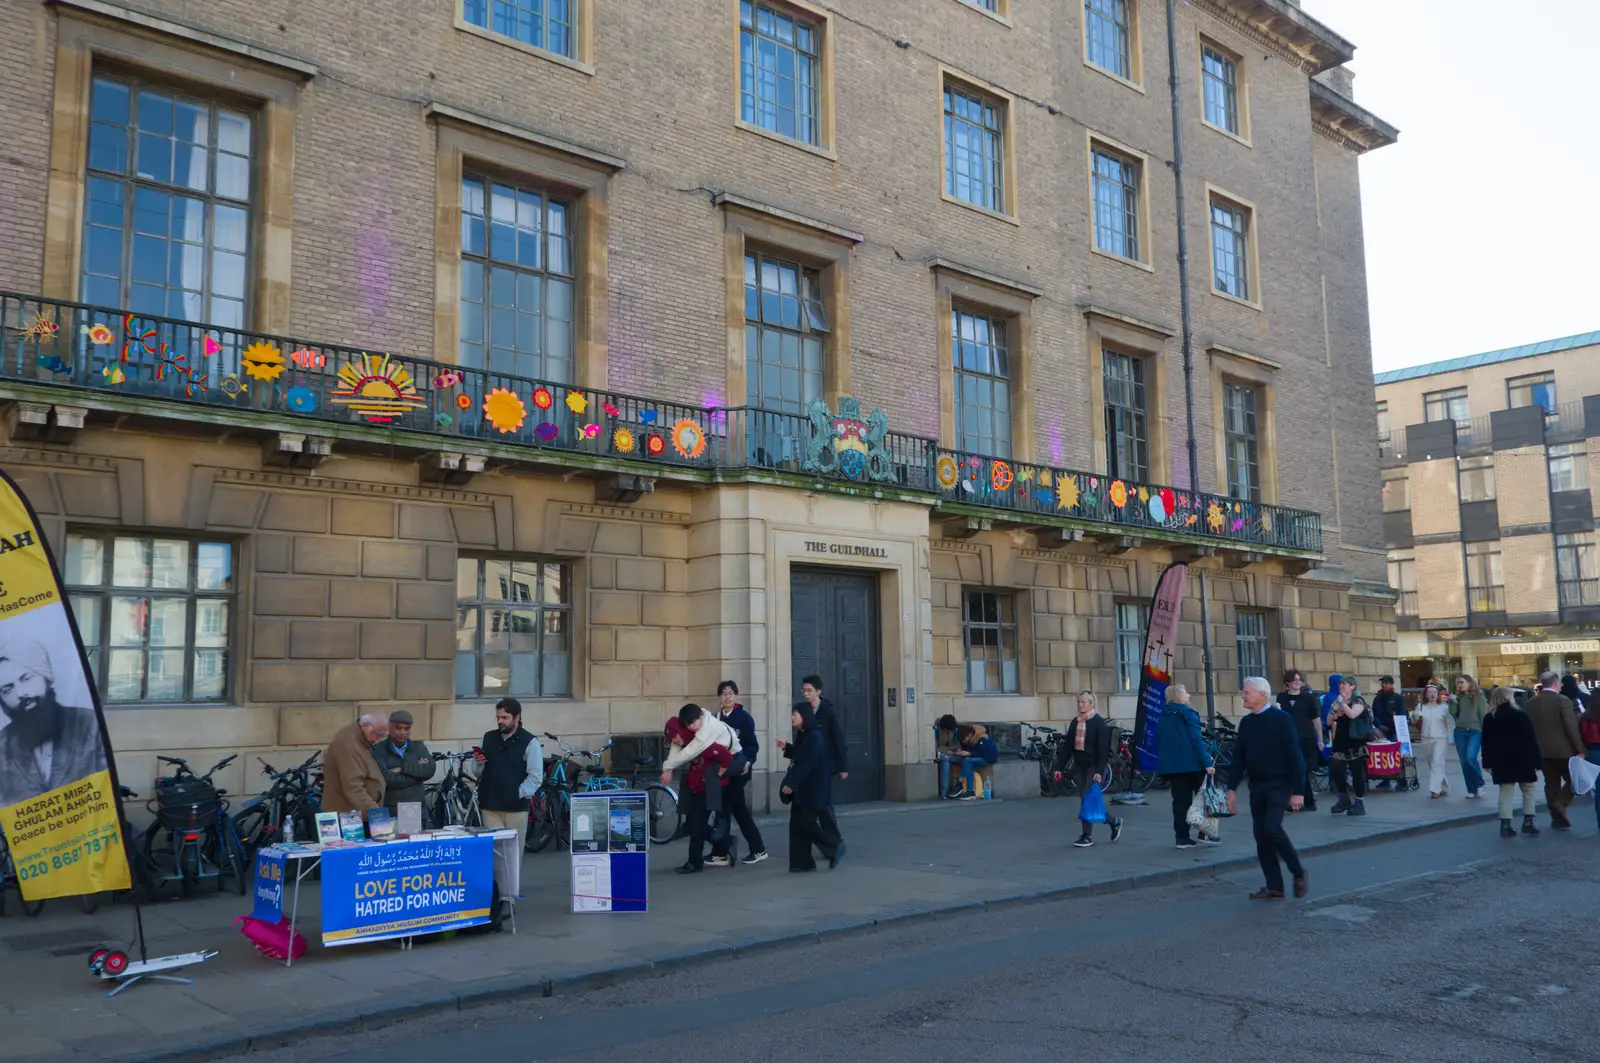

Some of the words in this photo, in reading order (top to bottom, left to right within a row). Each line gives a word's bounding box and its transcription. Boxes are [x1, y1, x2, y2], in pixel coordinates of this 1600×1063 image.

[804, 541, 827, 553] THE
[830, 543, 887, 558] GUILDHALL
[1368, 751, 1400, 769] JESUS
[14, 806, 64, 831] GHULAM
[15, 795, 61, 818] HAZRAT
[12, 825, 46, 846] peace
[48, 820, 64, 832] be
[88, 802, 109, 814] him
[19, 861, 49, 881] 020
[84, 831, 119, 856] 7871
[355, 878, 397, 899] LOVE
[402, 873, 432, 893] FOR
[436, 871, 466, 888] ALL
[355, 896, 404, 918] HATRED
[406, 892, 430, 910] FOR
[432, 888, 466, 906] NONE
[355, 923, 395, 935] AHMADIYYA
[396, 919, 422, 930] MUSLIM
[423, 913, 460, 925] COMMUNITY
